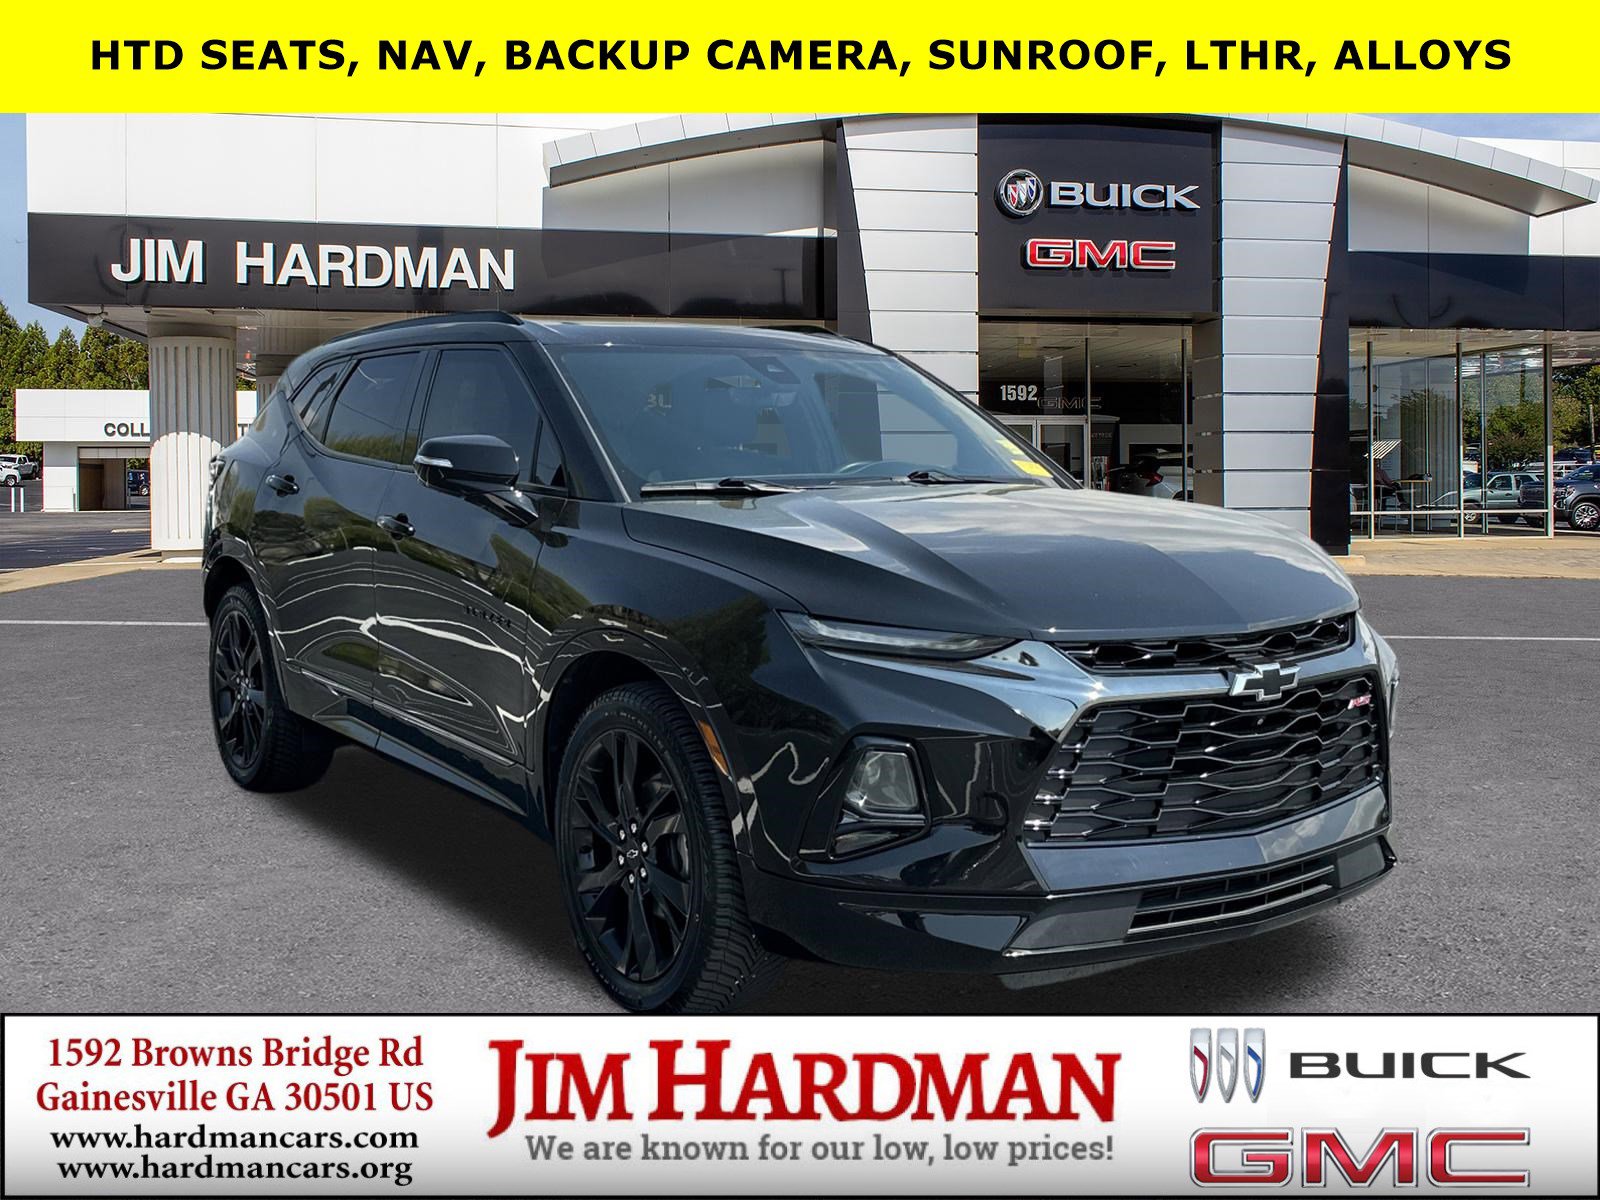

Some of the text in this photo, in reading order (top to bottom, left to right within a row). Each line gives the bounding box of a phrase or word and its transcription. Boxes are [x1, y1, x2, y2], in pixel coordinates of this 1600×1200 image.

[1051, 182, 1201, 209] BUICK
[111, 238, 514, 290] JIM HARDMAN
[1025, 238, 1176, 270] GMC
[1000, 384, 1038, 401] 1592
[1037, 397, 1102, 409] GMC
